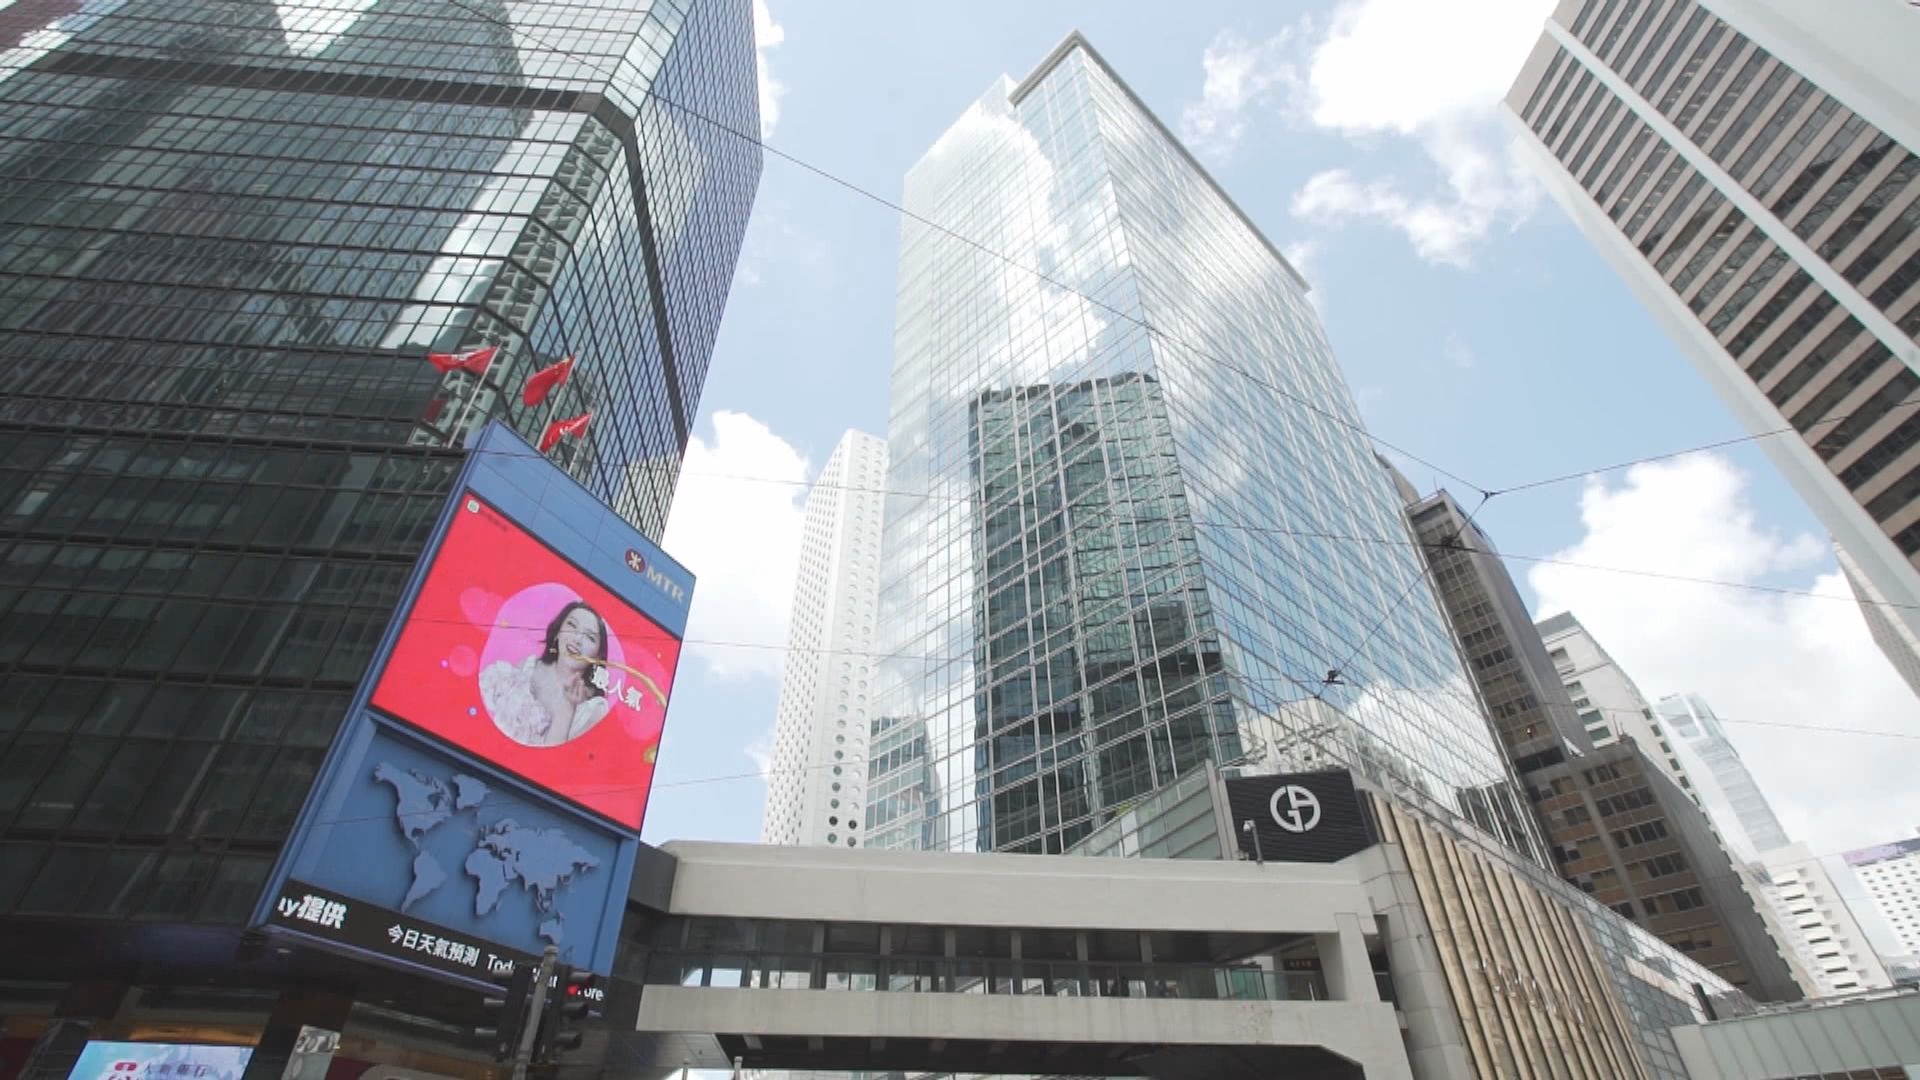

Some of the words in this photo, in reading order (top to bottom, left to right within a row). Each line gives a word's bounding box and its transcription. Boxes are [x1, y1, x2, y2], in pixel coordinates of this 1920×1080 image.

[646, 565, 684, 605] MTR
[387, 923, 481, 969] 今日天氣預測
